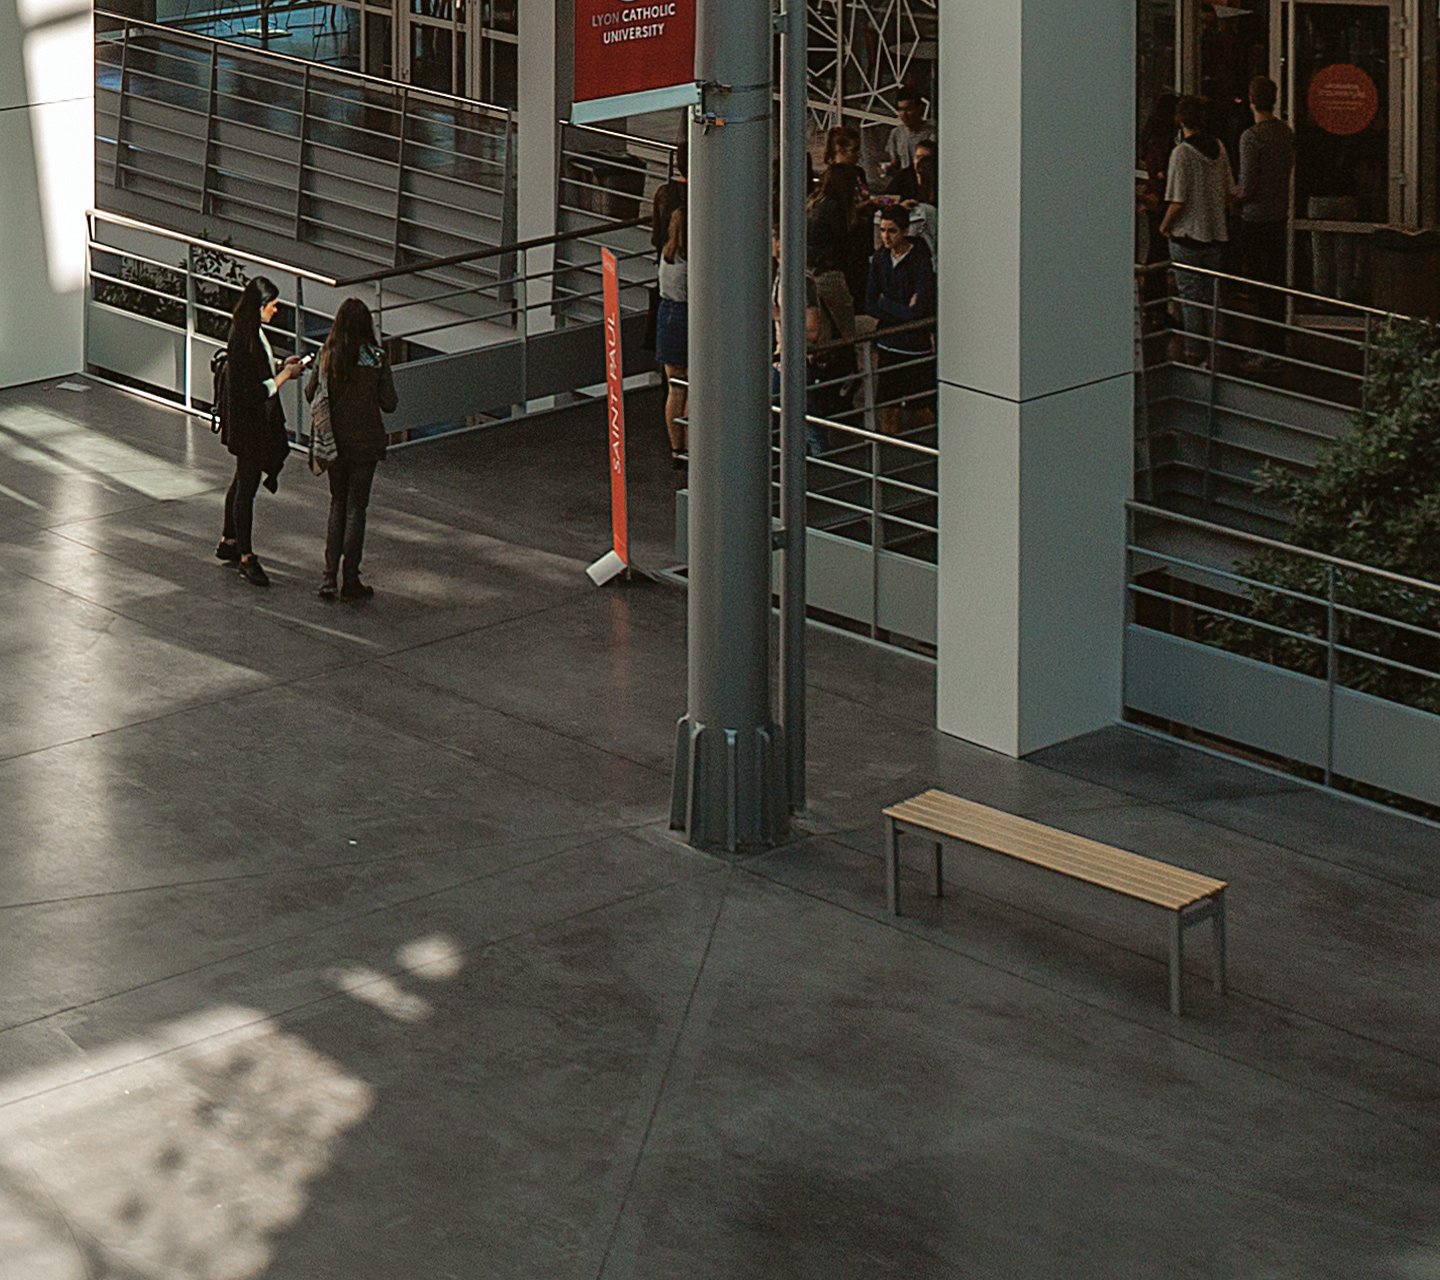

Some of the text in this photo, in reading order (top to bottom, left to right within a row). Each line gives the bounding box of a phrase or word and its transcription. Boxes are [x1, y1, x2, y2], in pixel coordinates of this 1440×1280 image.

[591, 3, 676, 27] LYON CATHOLIC
[603, 23, 665, 44] UNIVERSITY
[606, 312, 622, 474] SAINT PAUL
